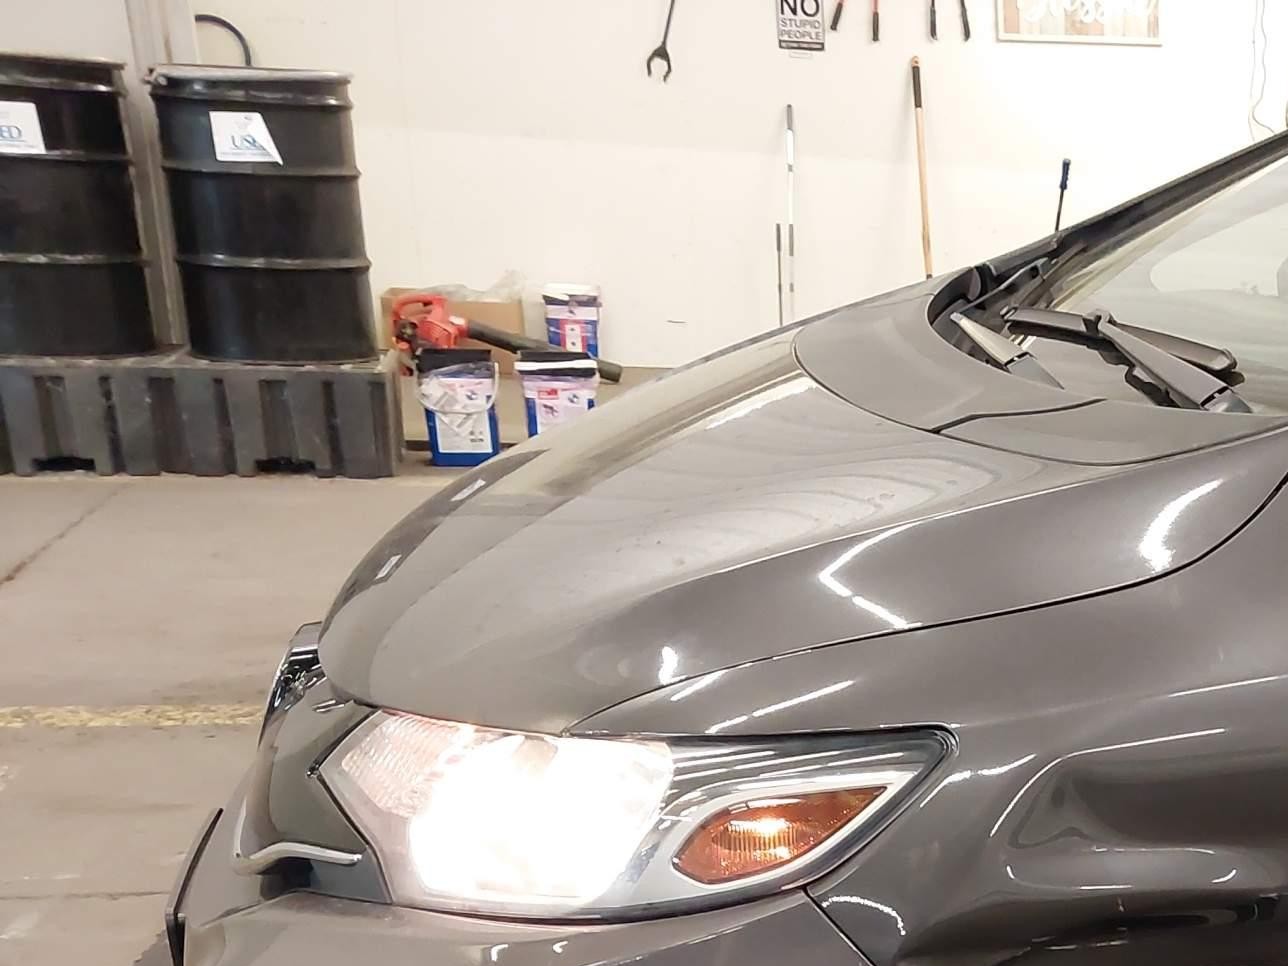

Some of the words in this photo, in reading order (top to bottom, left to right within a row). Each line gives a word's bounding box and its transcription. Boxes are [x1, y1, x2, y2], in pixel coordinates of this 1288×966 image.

[780, 0, 820, 17] NO
[780, 18, 821, 29] STUPID
[780, 29, 823, 40] PEOPLE
